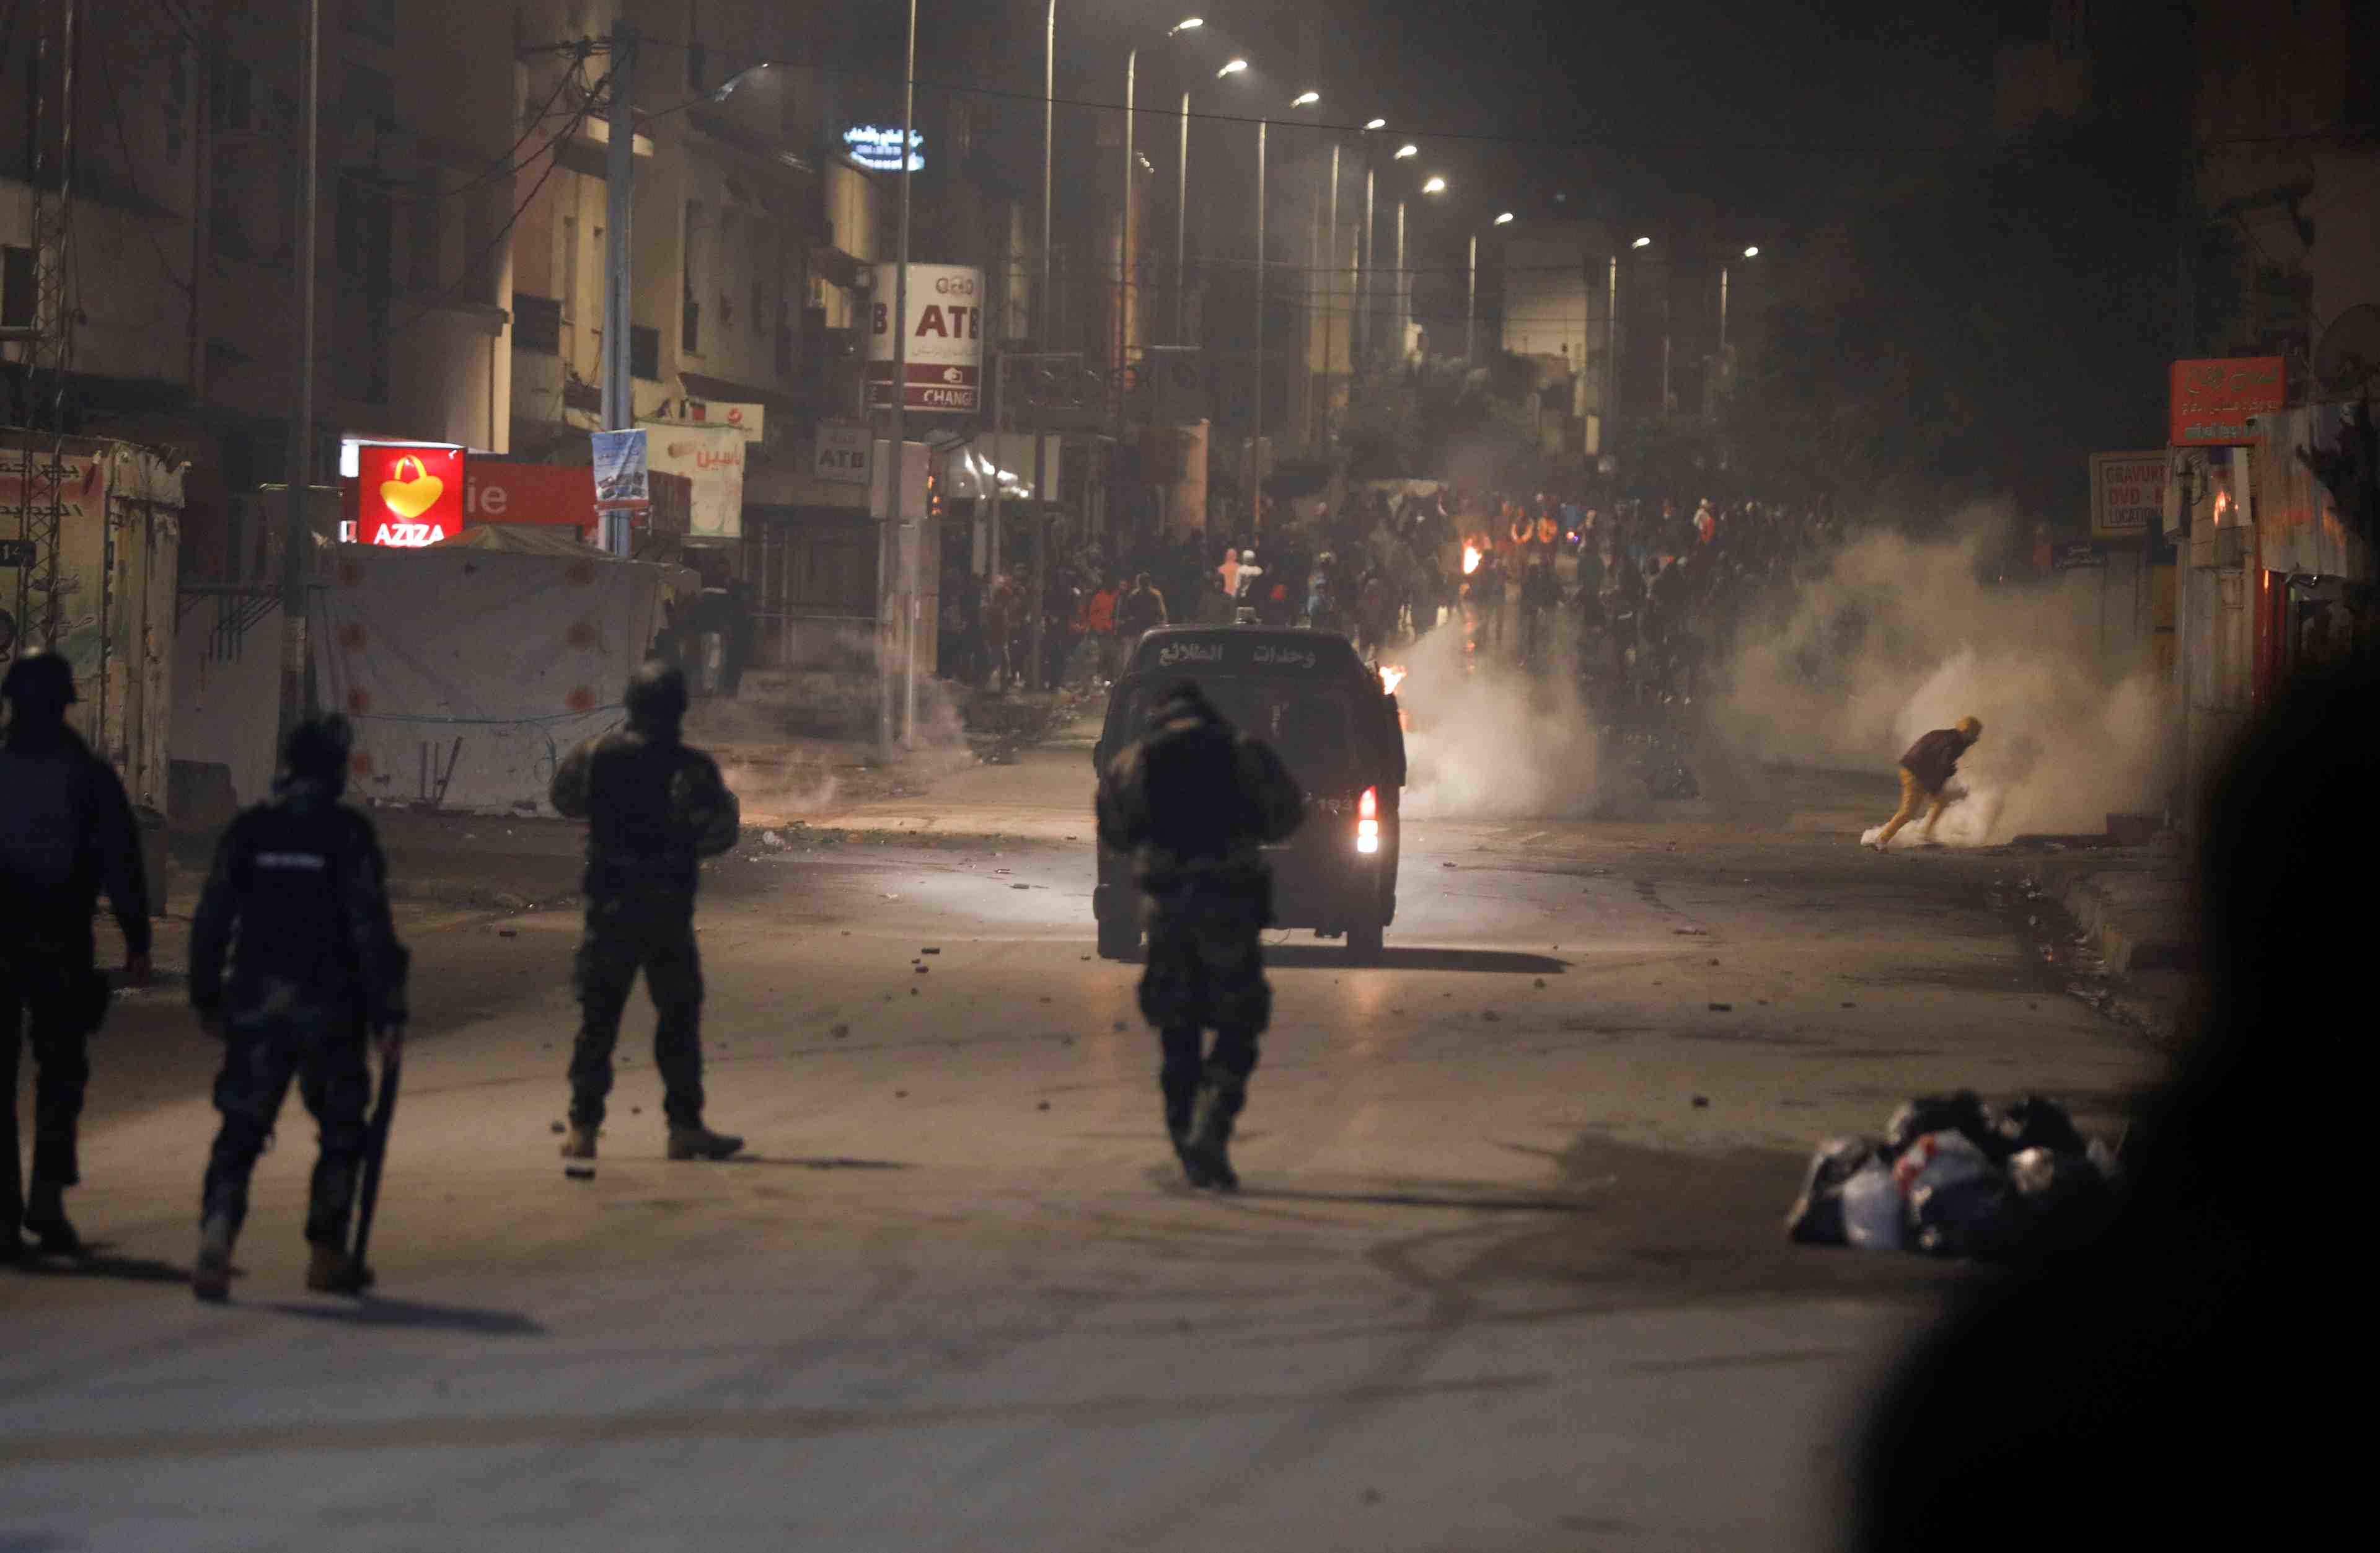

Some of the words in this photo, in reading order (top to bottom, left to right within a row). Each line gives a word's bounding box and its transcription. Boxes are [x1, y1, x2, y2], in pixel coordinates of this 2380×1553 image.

[915, 304, 981, 338] ATB
[819, 449, 863, 467] ATB
[2109, 488, 2140, 505] DVD
[374, 523, 445, 547] AZIZA
[1253, 644, 1316, 668] وحدات
